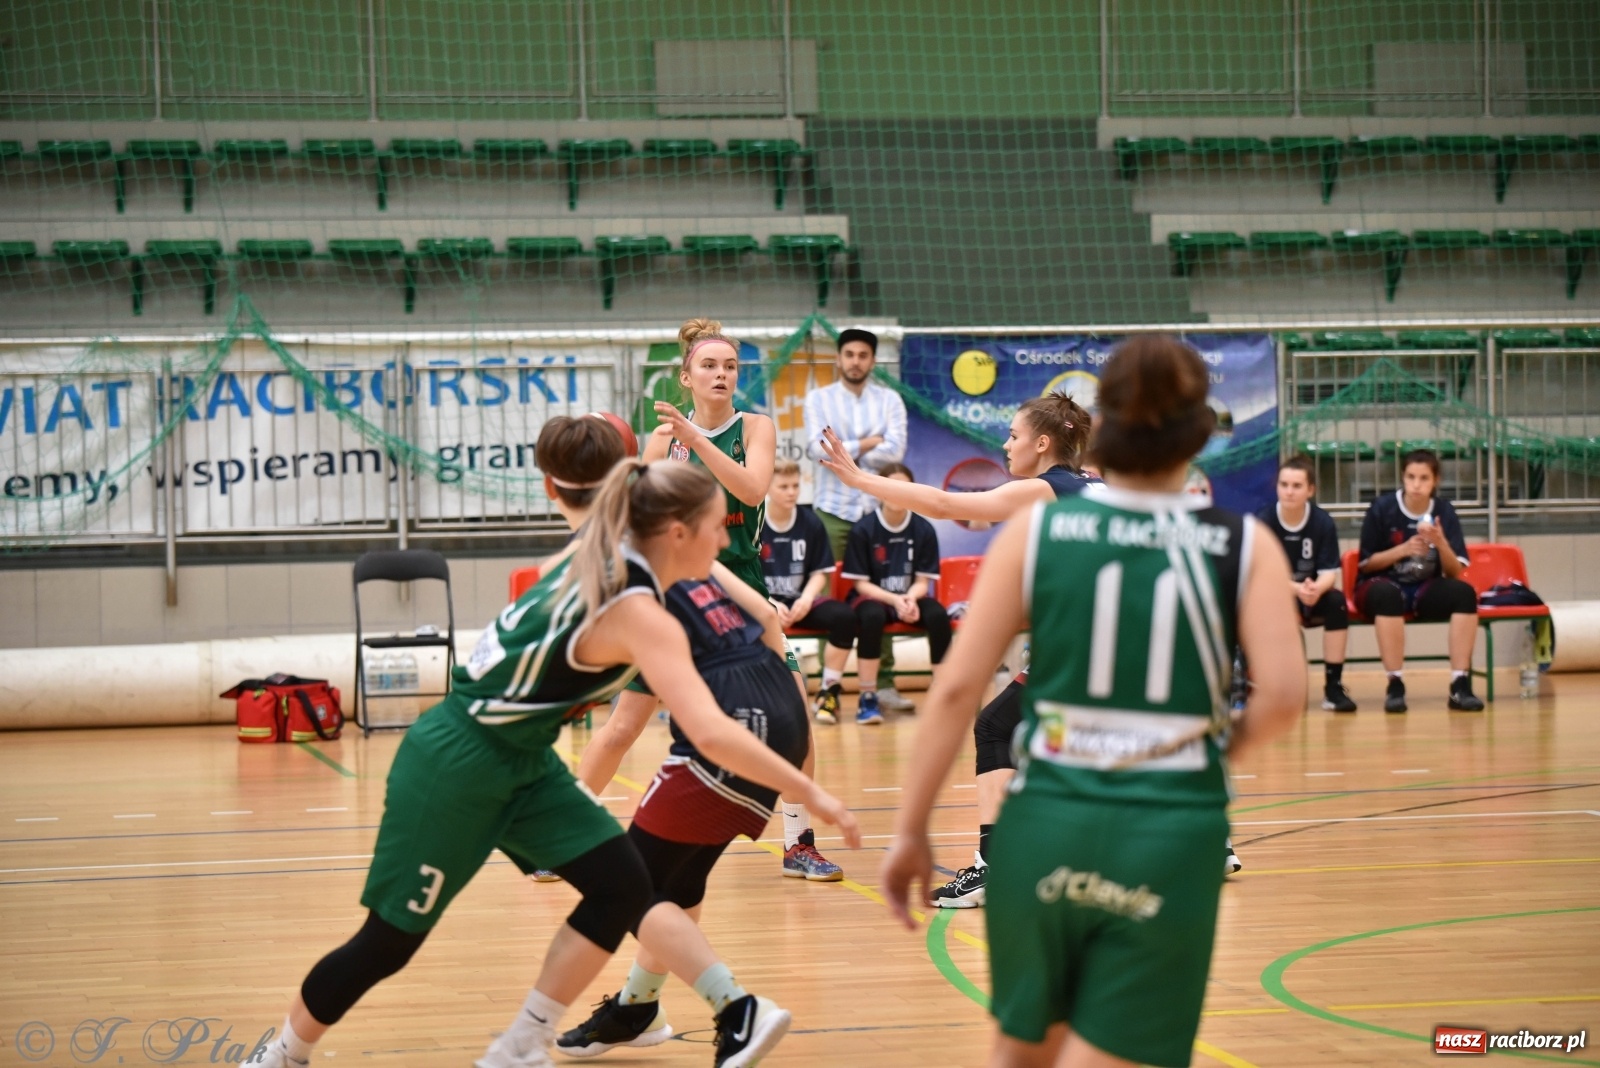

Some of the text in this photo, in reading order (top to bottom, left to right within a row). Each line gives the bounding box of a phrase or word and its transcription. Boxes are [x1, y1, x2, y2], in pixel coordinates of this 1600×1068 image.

[1086, 350, 1113, 367] Spo
[157, 356, 578, 425] RACIBORSKI
[791, 539, 806, 561] 10
[1302, 538, 1313, 559] 8
[1087, 559, 1178, 704] 11
[407, 864, 445, 915] 3
